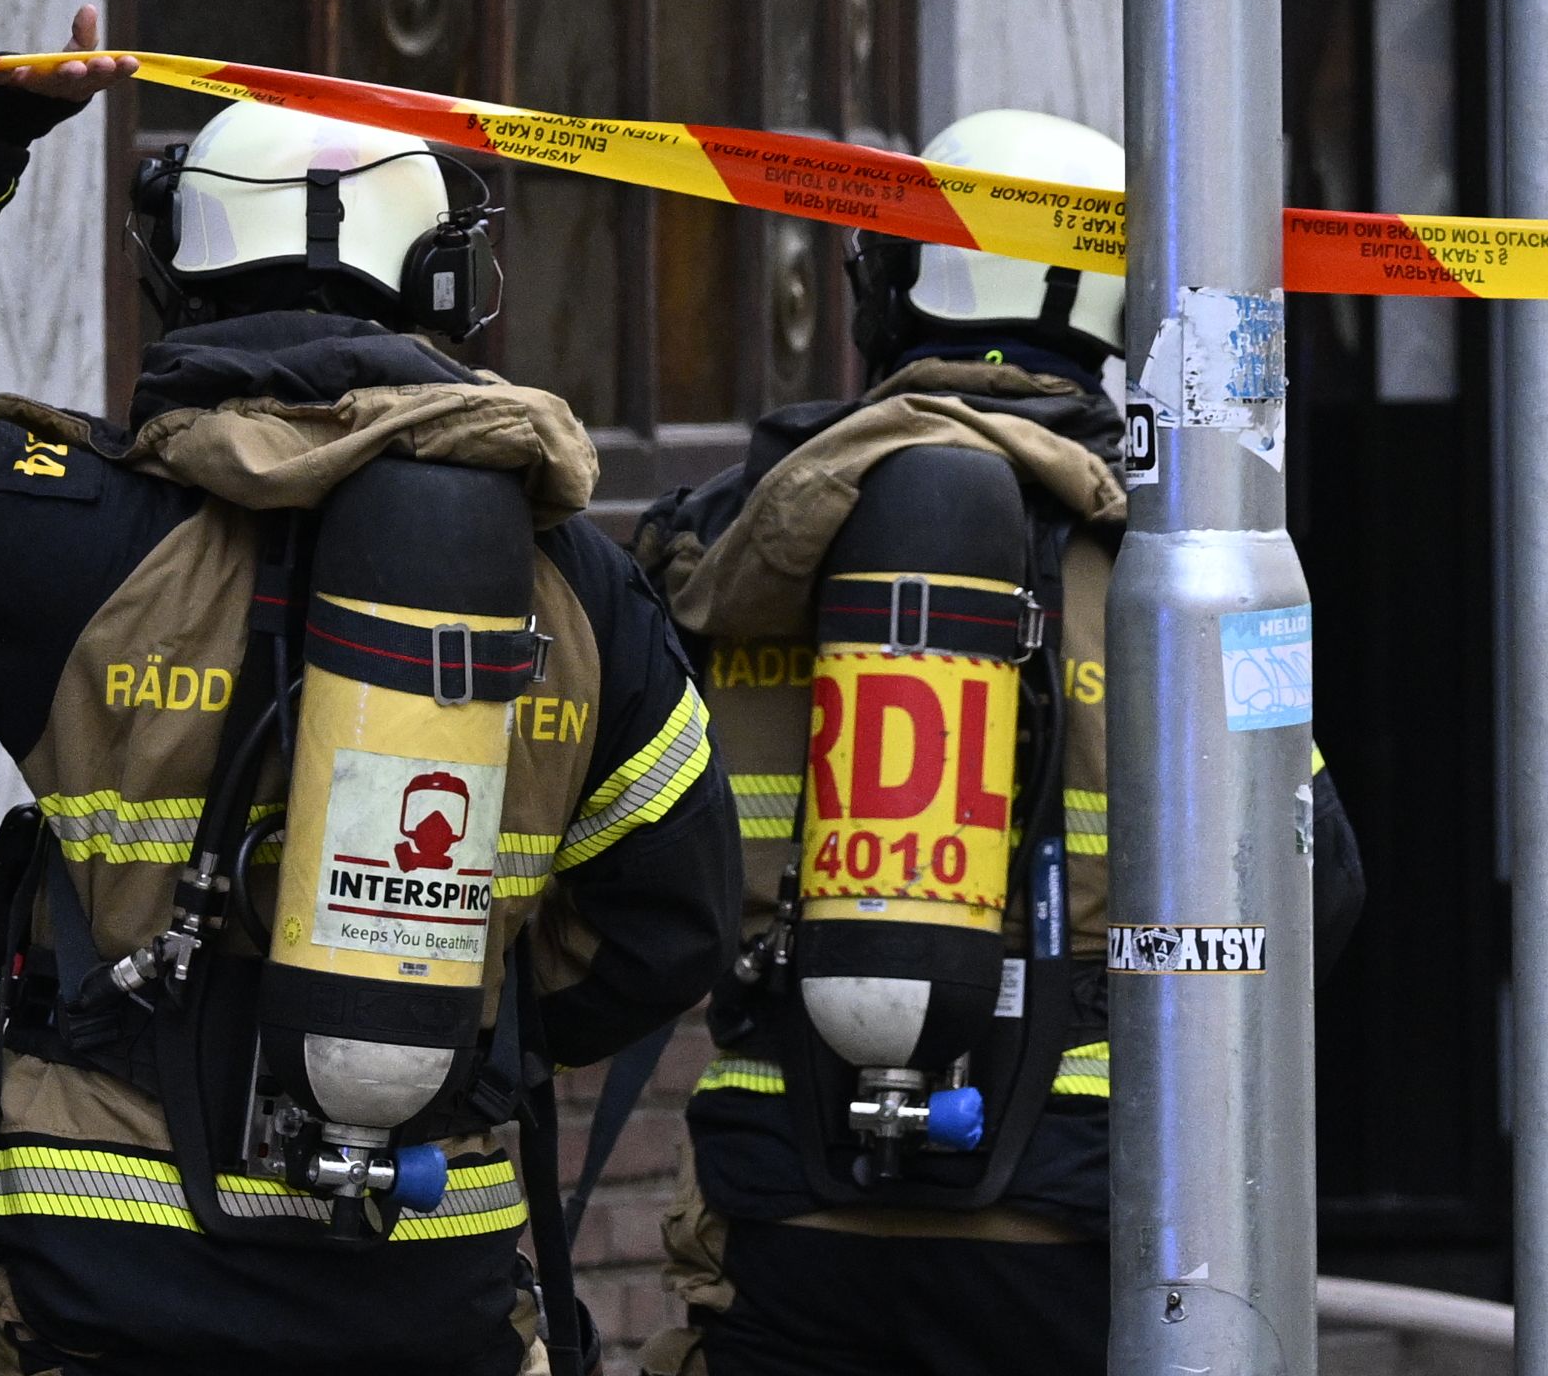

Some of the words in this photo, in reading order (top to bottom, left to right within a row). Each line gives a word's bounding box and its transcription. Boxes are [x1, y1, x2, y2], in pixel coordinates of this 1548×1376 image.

[480, 117, 490, 132] 2
[495, 119, 530, 140] KAP.
[534, 127, 545, 141] 6
[547, 129, 608, 153] ENLIGT
[990, 186, 1070, 209] OLYCKOR
[1073, 198, 1111, 214] MOT
[1081, 216, 1117, 235] KAP.
[1259, 615, 1307, 637] HELLO
[105, 654, 233, 712] RÄDD
[808, 672, 1008, 832] RDL
[815, 830, 968, 885] 4010
[330, 870, 491, 912] INTERSPIRO
[341, 923, 388, 945] Keeps
[393, 930, 420, 947] You
[425, 932, 479, 954] Breathing
[1176, 928, 1266, 971] ATSV
